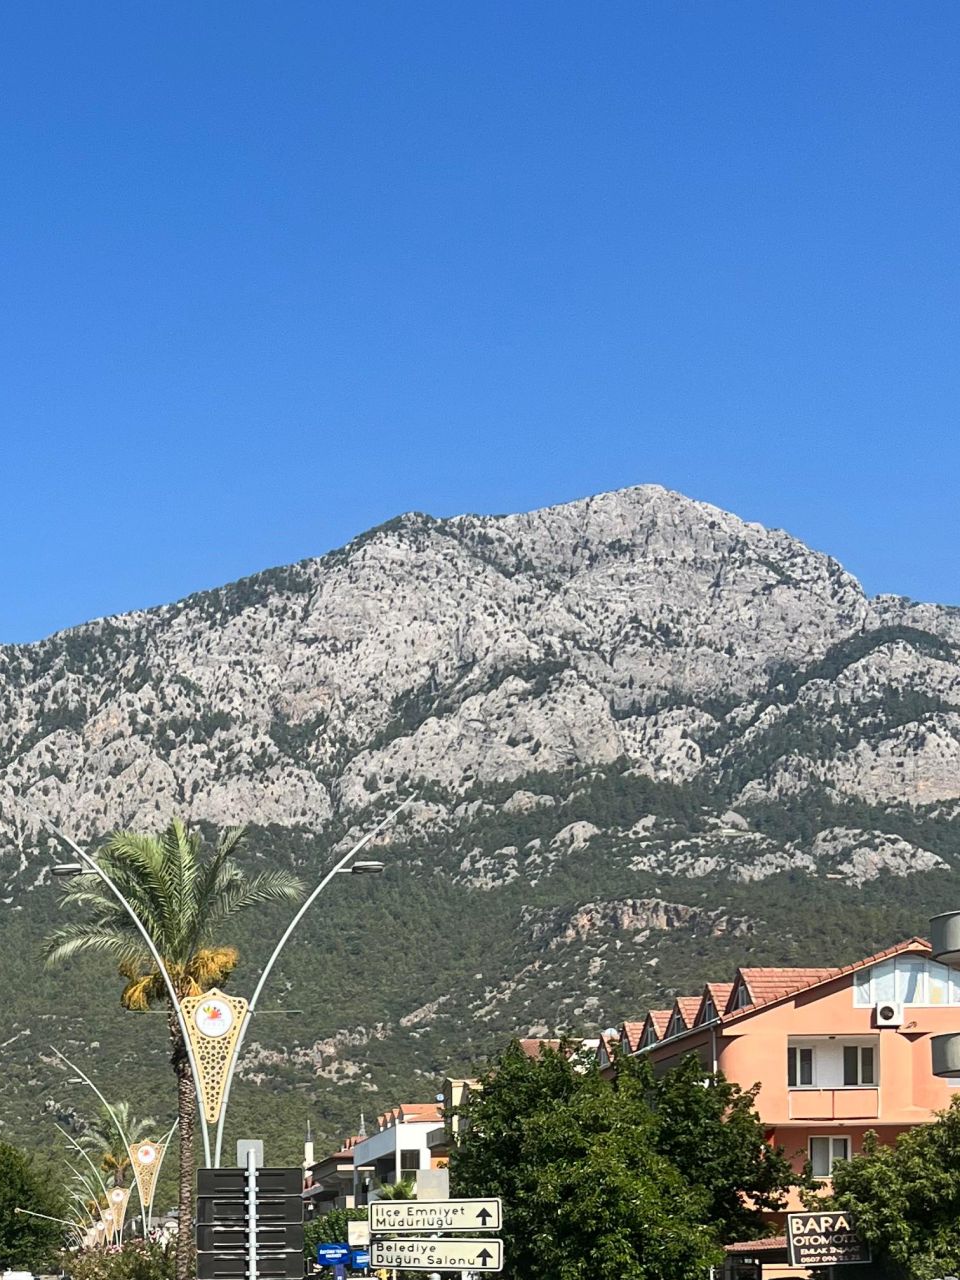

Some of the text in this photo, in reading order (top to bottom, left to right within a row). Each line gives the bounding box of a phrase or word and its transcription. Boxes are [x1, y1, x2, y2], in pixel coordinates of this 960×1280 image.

[376, 1205, 465, 1218] İlçe Emniyet
[376, 1243, 437, 1254] Belediye
[376, 1254, 421, 1266] Düğün
[427, 1256, 476, 1266] Salonu
